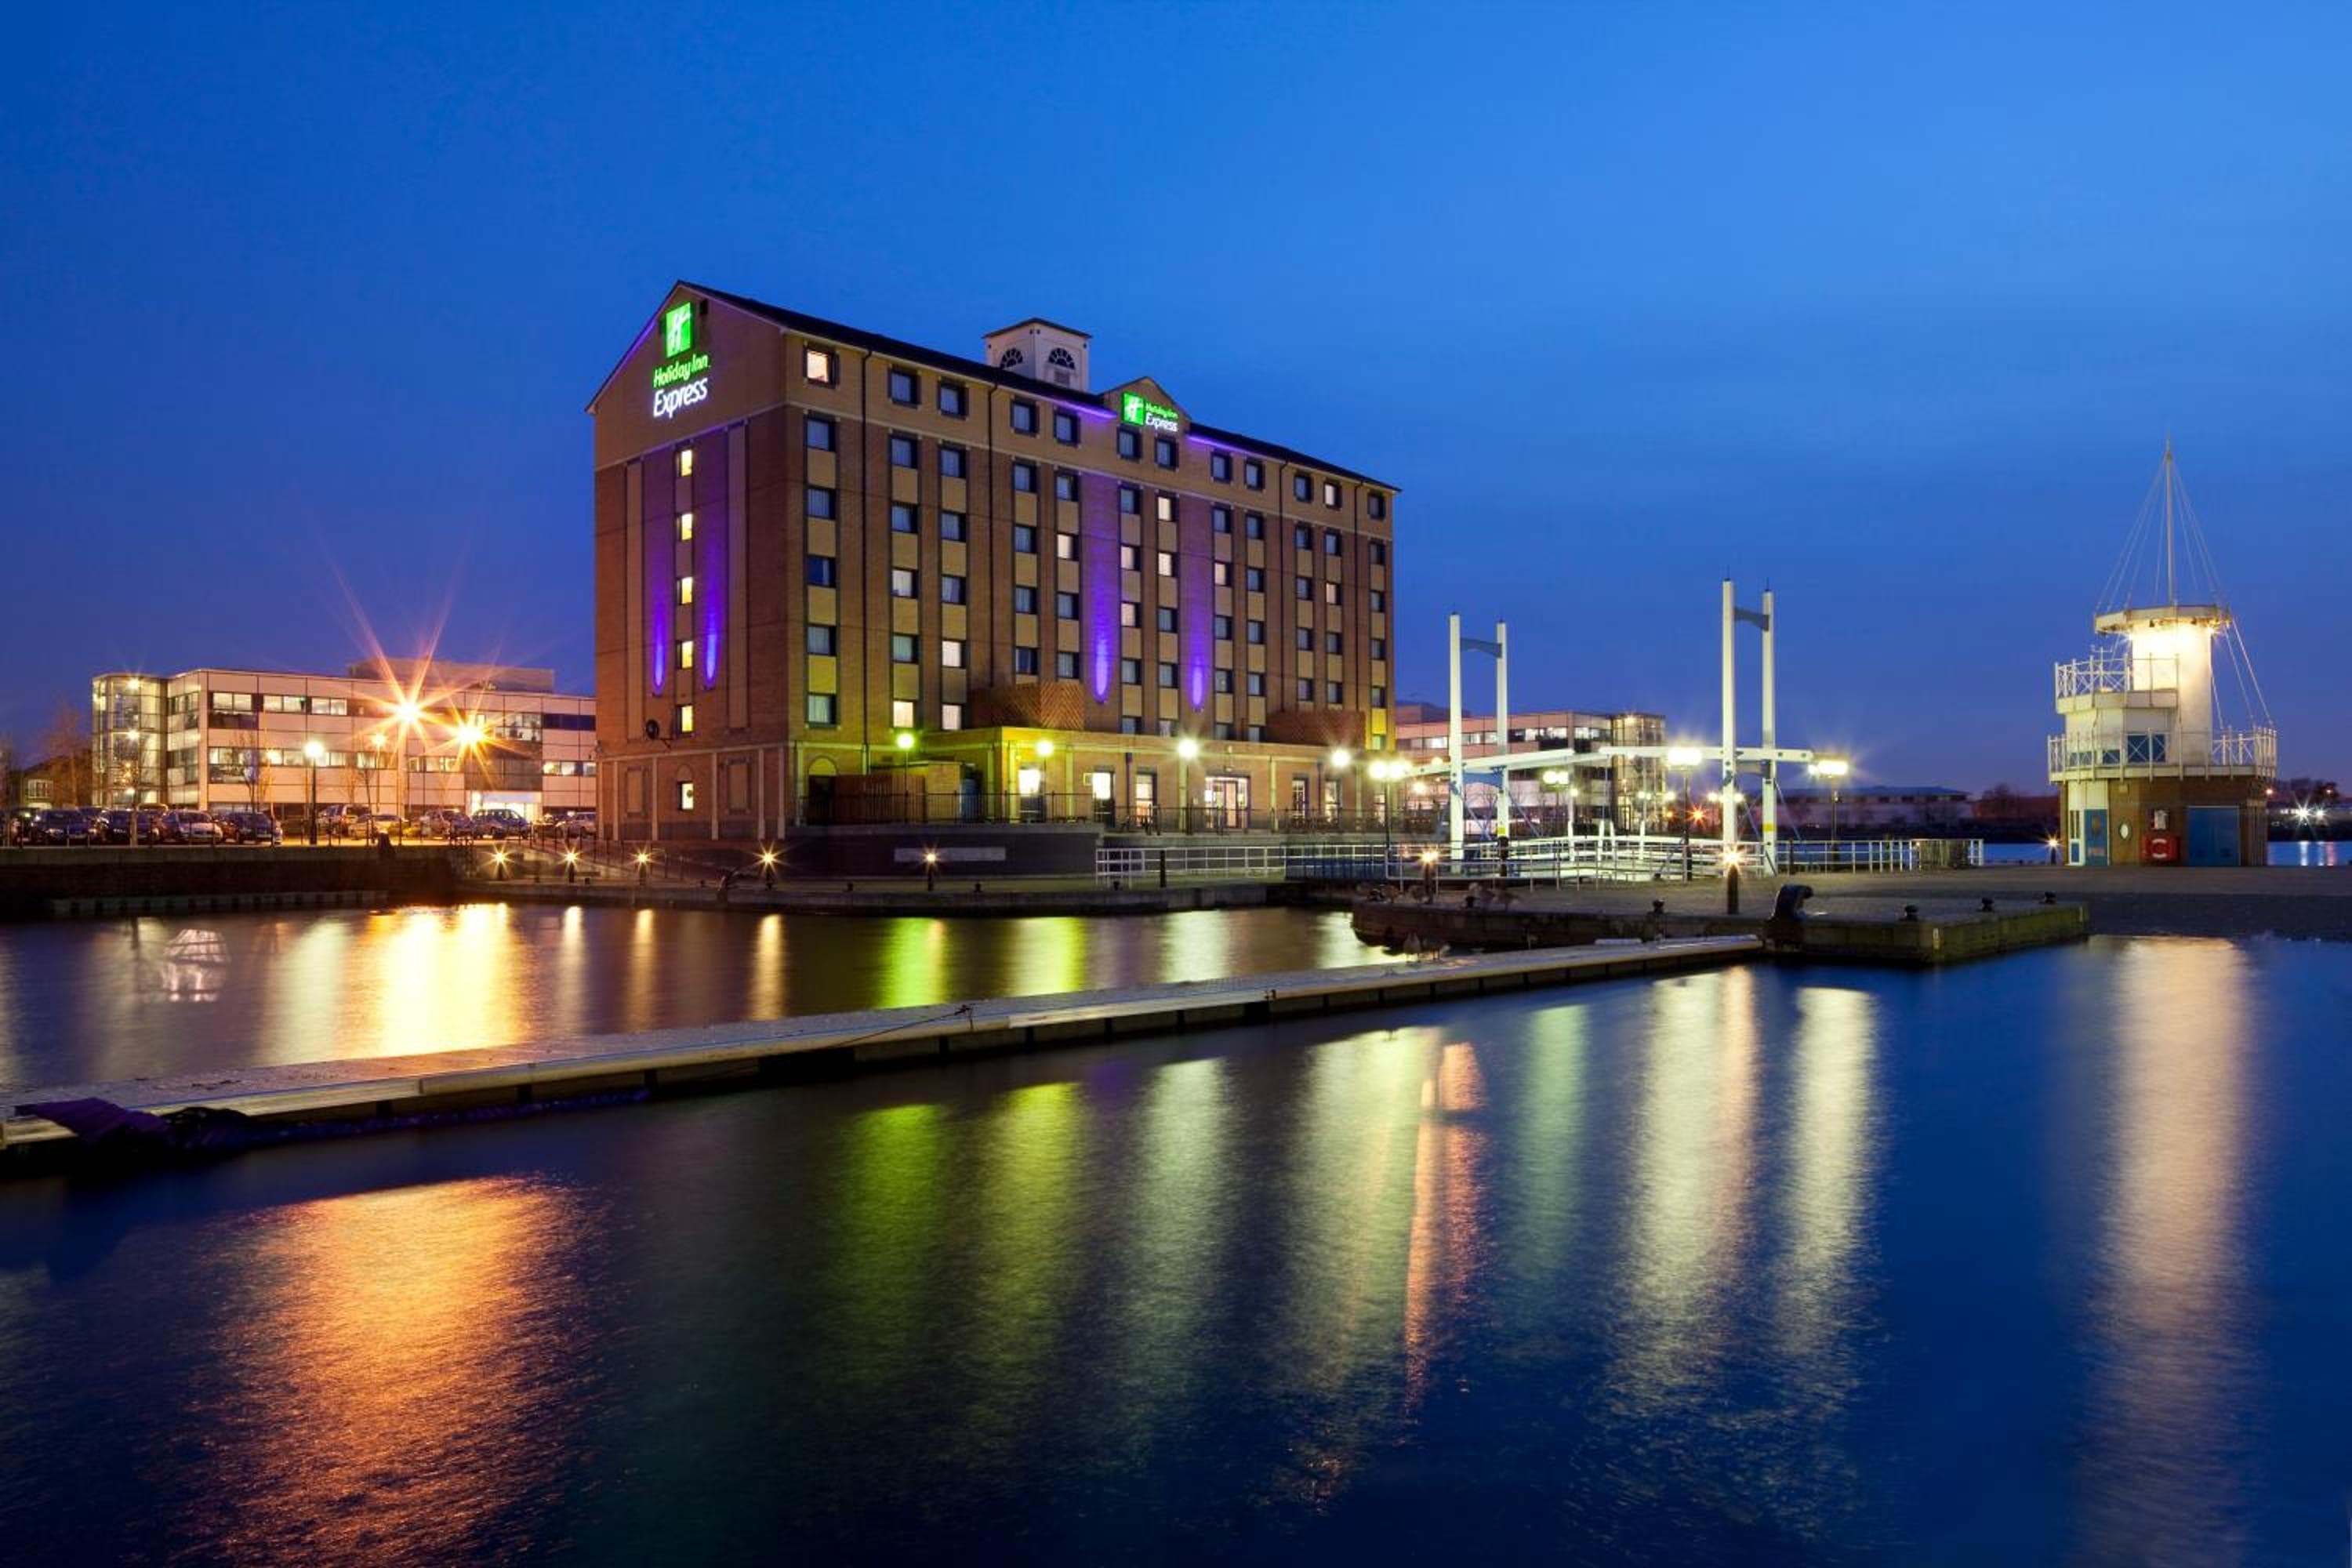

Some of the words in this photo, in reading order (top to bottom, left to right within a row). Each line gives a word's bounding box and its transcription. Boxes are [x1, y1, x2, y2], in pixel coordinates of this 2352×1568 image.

[654, 361, 691, 387] Holiday
[691, 354, 708, 372] Inn
[654, 377, 708, 419] Express
